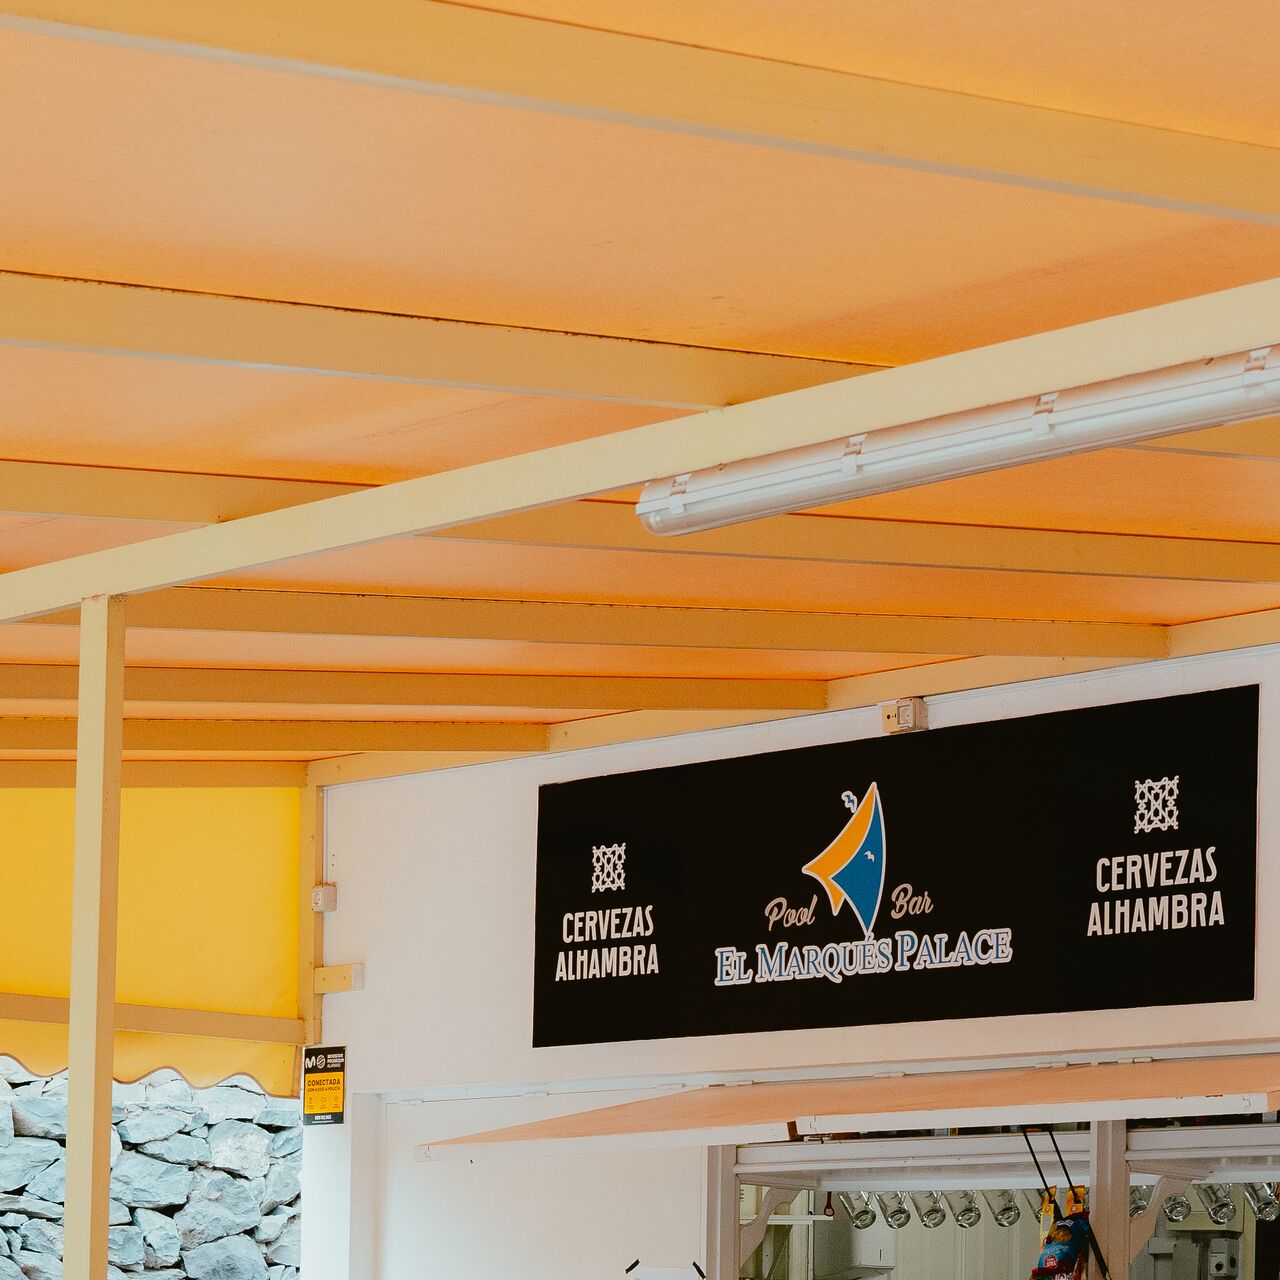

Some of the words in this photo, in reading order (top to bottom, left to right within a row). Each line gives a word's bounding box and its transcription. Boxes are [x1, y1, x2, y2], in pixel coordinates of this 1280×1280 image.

[1096, 846, 1218, 892] CERVEZAS
[562, 904, 654, 944] CERVEZAS
[764, 894, 818, 932] Pool
[890, 883, 934, 920] Bar
[1087, 890, 1225, 937] ALHAMBRA
[554, 943, 659, 982] ALHAMBRA
[307, 1078, 341, 1087] CONECTADA
